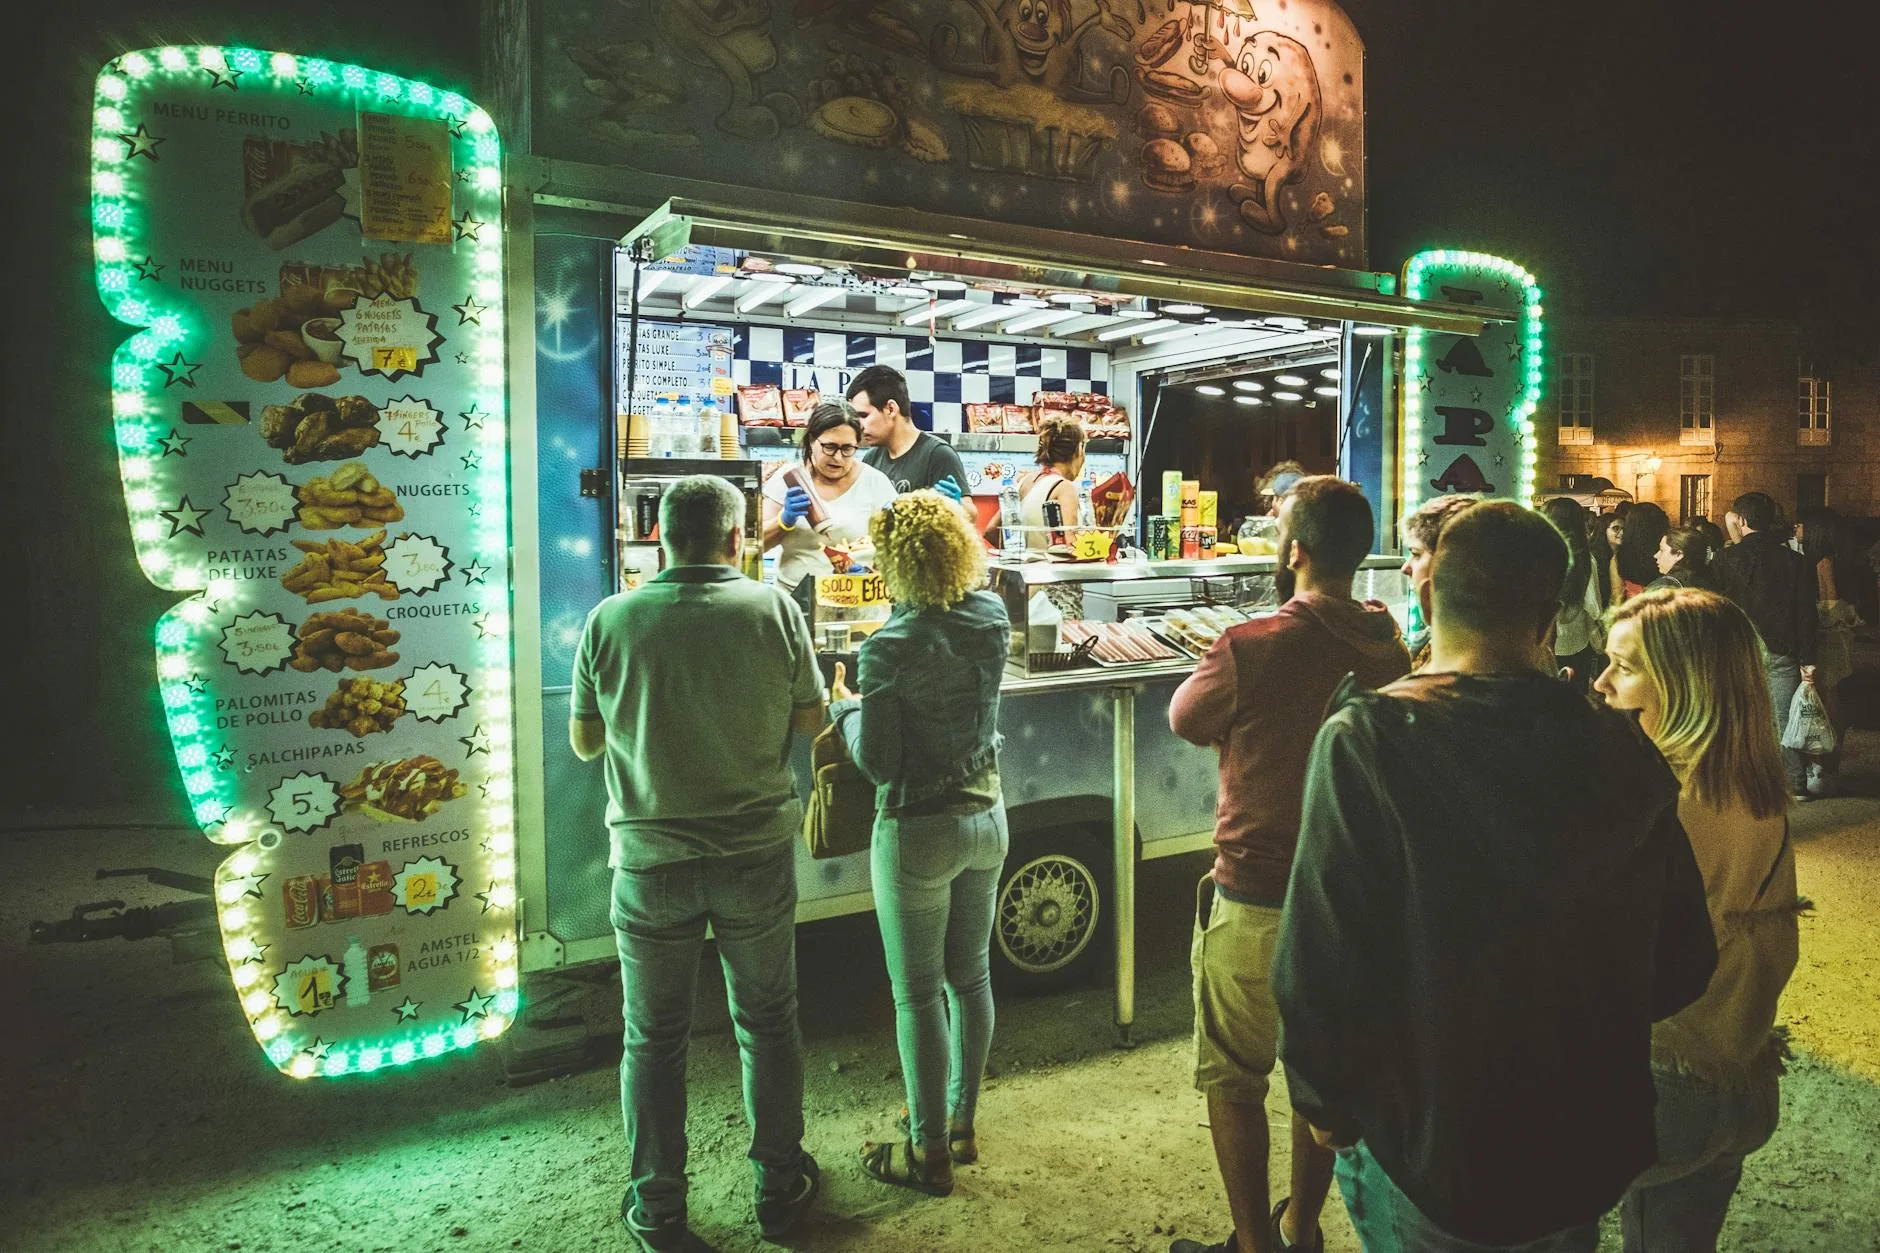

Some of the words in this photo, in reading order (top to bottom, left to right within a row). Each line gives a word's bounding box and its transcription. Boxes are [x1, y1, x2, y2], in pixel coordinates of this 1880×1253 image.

[153, 102, 209, 120] MENU
[215, 108, 290, 130] PERRITO
[180, 258, 233, 273] MENU
[180, 276, 266, 293] NUGGETS
[652, 329, 679, 341] GRANDE
[652, 345, 669, 355] LUXE
[652, 360, 675, 371] SIMPLE
[652, 375, 687, 387] COMPLETO
[396, 483, 470, 496] NUGGETS
[207, 548, 287, 563] PATATAS
[209, 566, 277, 580] DELUXE
[822, 579, 853, 593] SOLO
[386, 602, 480, 620] CROQUETAS
[216, 690, 317, 712] PALOMITAS
[216, 716, 240, 729] DE
[246, 709, 303, 727] POLLO
[247, 741, 365, 767] SALCHIPAPAS
[382, 828, 470, 852] REFRESCOS
[420, 933, 480, 953] AMSTEL
[408, 954, 451, 972] AGUA
[457, 948, 479, 962] 1/2
